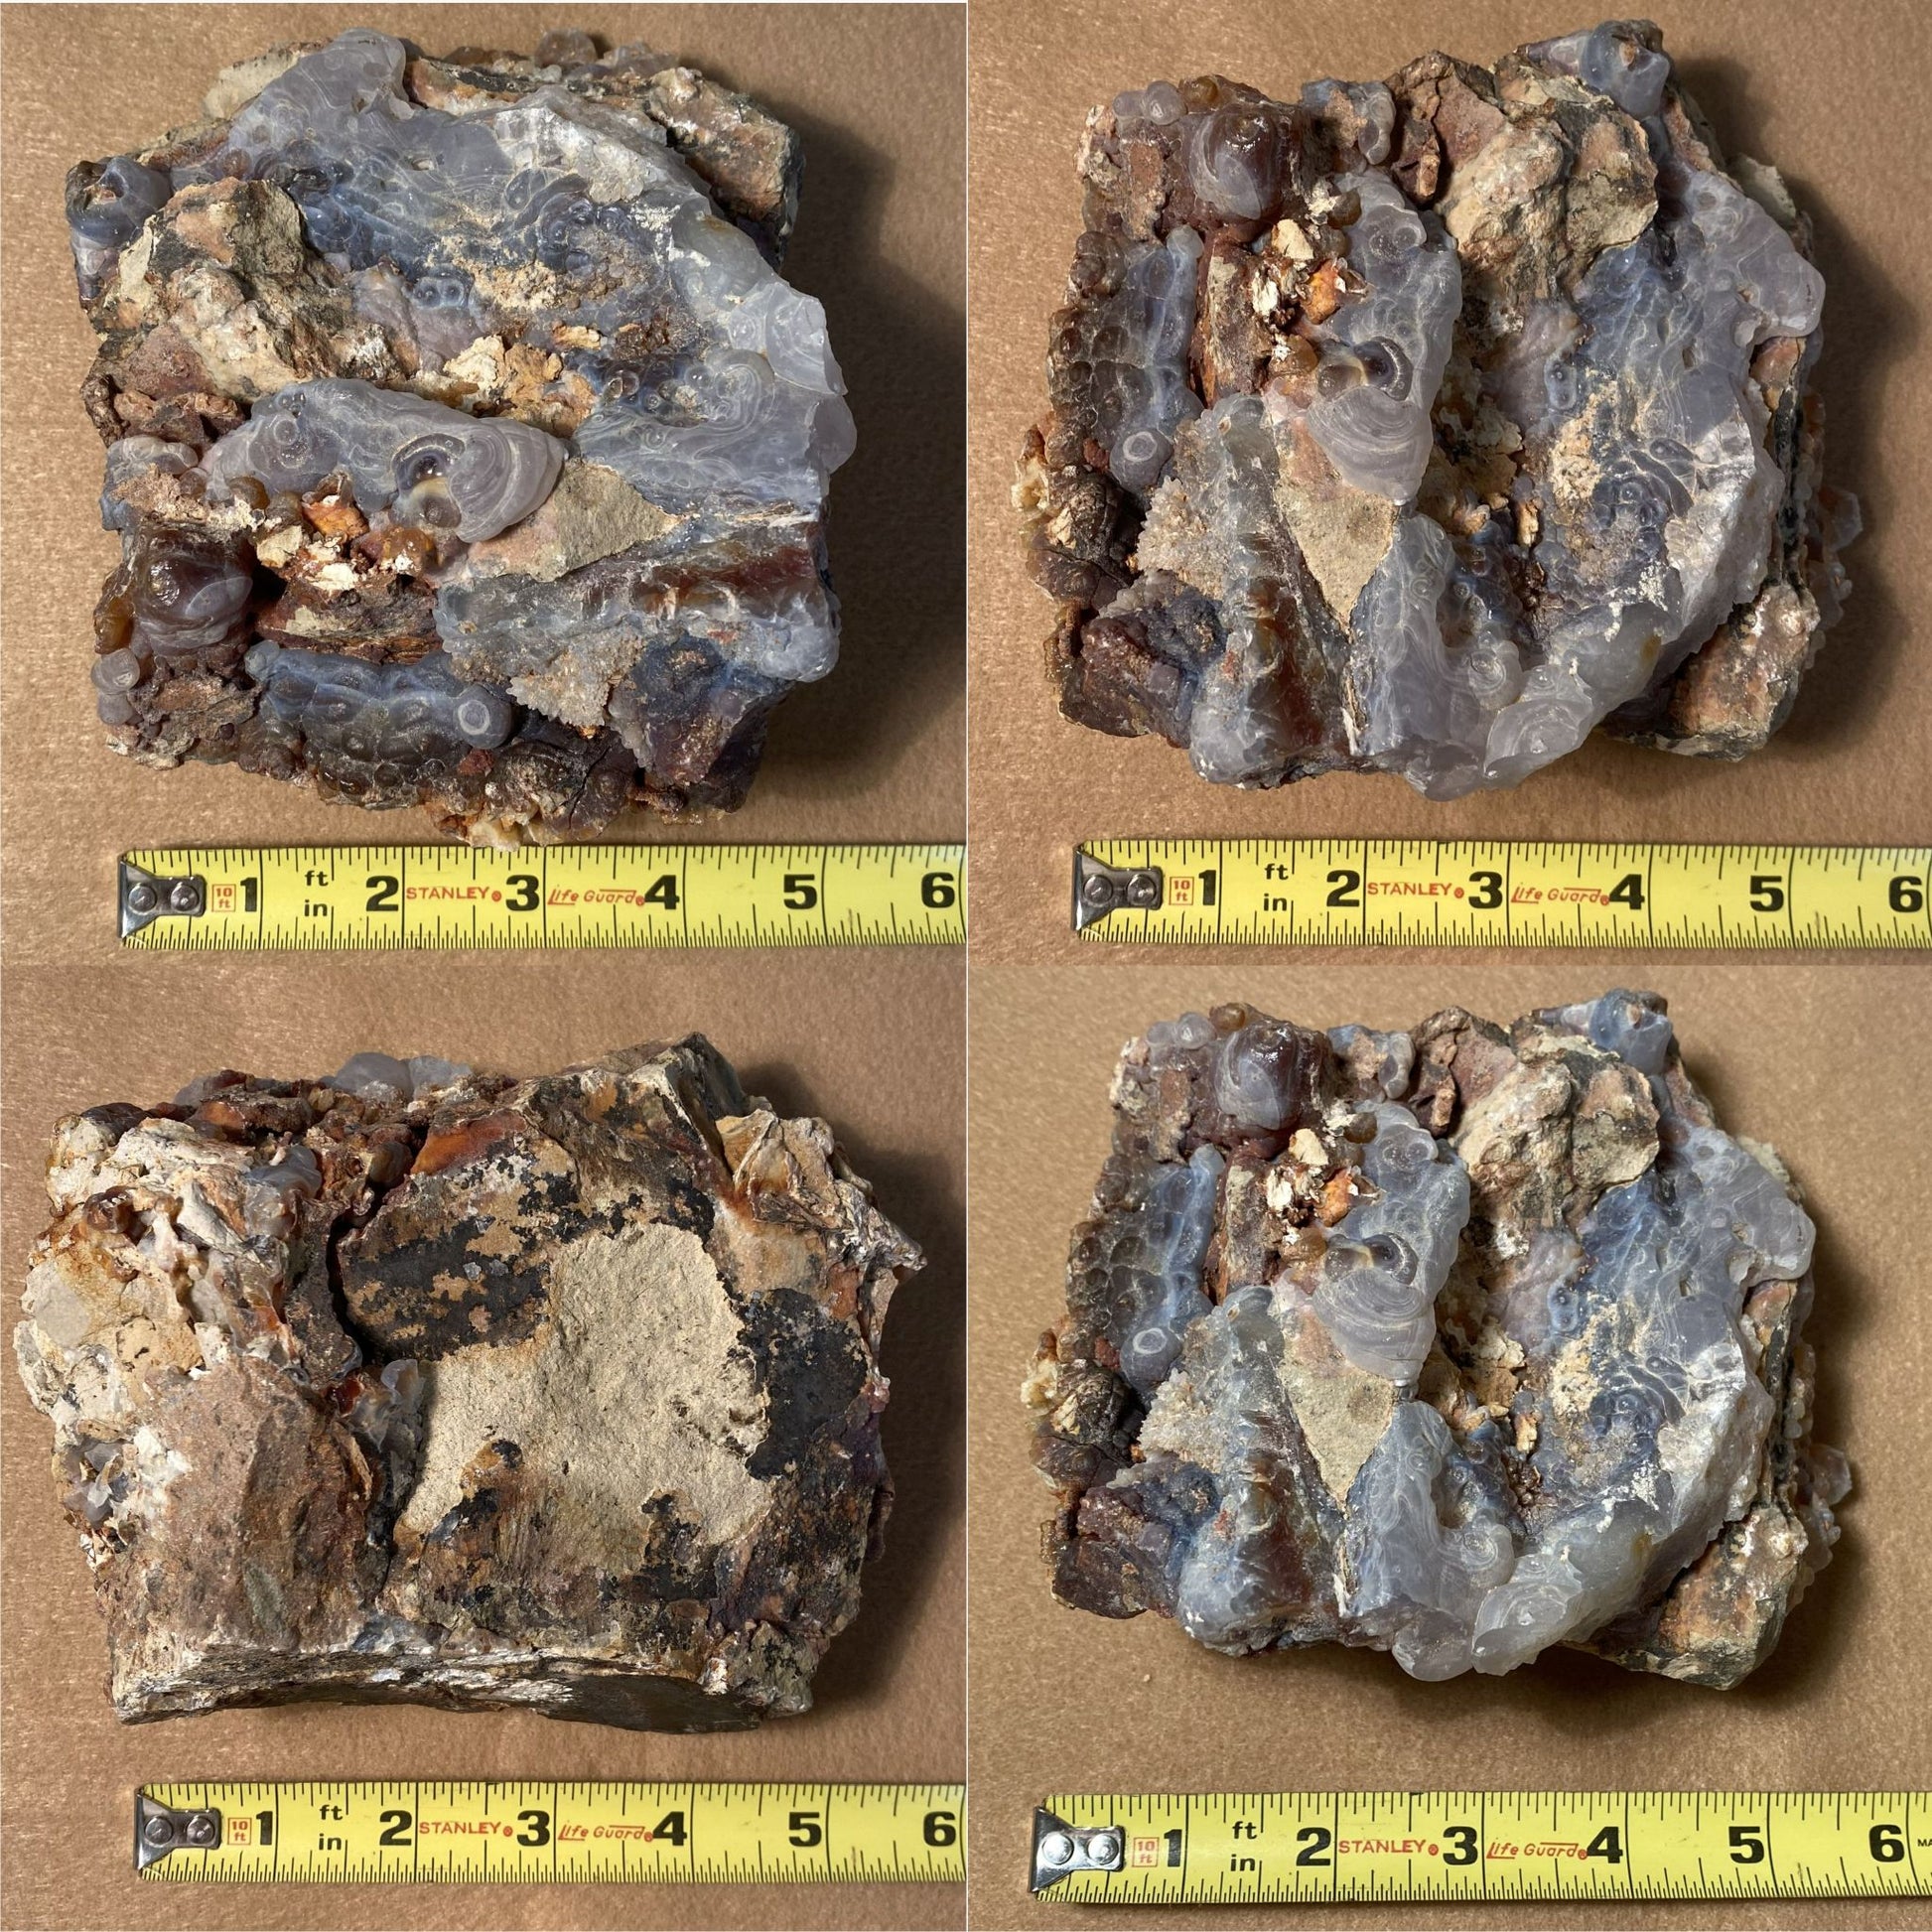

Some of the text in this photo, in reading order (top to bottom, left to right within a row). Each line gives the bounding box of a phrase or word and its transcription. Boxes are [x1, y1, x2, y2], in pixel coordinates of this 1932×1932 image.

[305, 870, 329, 887] ft
[1173, 880, 1190, 891] 10
[1198, 870, 1216, 906] 1
[1265, 863, 1289, 881] ft
[1326, 870, 1360, 907] 2
[216, 887, 232, 898] 10
[218, 898, 231, 910] ft
[240, 877, 258, 912] 1
[365, 876, 399, 912] 2
[505, 875, 539, 911] 3
[548, 884, 579, 905] Life
[644, 874, 680, 910] 4
[783, 874, 818, 910] 5
[920, 872, 955, 908] 6
[1175, 891, 1189, 902] ft
[1263, 894, 1288, 911] in
[1468, 871, 1503, 909] 3
[1511, 885, 1543, 904] Life
[1608, 874, 1645, 910] 4
[1749, 875, 1784, 912] 5
[1888, 876, 1923, 913] 6
[304, 899, 328, 917] in
[231, 1821, 248, 1831] 10
[255, 1811, 274, 1846] 1
[319, 1804, 344, 1821] ft
[379, 1810, 413, 1847] 2
[516, 1810, 551, 1847] 3
[652, 1811, 688, 1847] 4
[788, 1811, 822, 1847] 5
[922, 1811, 956, 1847] 6
[233, 1832, 246, 1842] ft
[319, 1833, 343, 1851] in
[557, 1820, 589, 1842] Life
[1137, 1841, 1155, 1853] 10
[1163, 1828, 1183, 1867] 1
[1232, 1821, 1257, 1840] ft
[1296, 1827, 1331, 1866] 2
[1443, 1826, 1478, 1865] 3
[1587, 1826, 1623, 1864] 4
[1728, 1826, 1764, 1864] 5
[1868, 1824, 1905, 1863] 6
[1138, 1853, 1153, 1865] ft
[1230, 1854, 1256, 1872] in
[1486, 1842, 1519, 1860] Life
